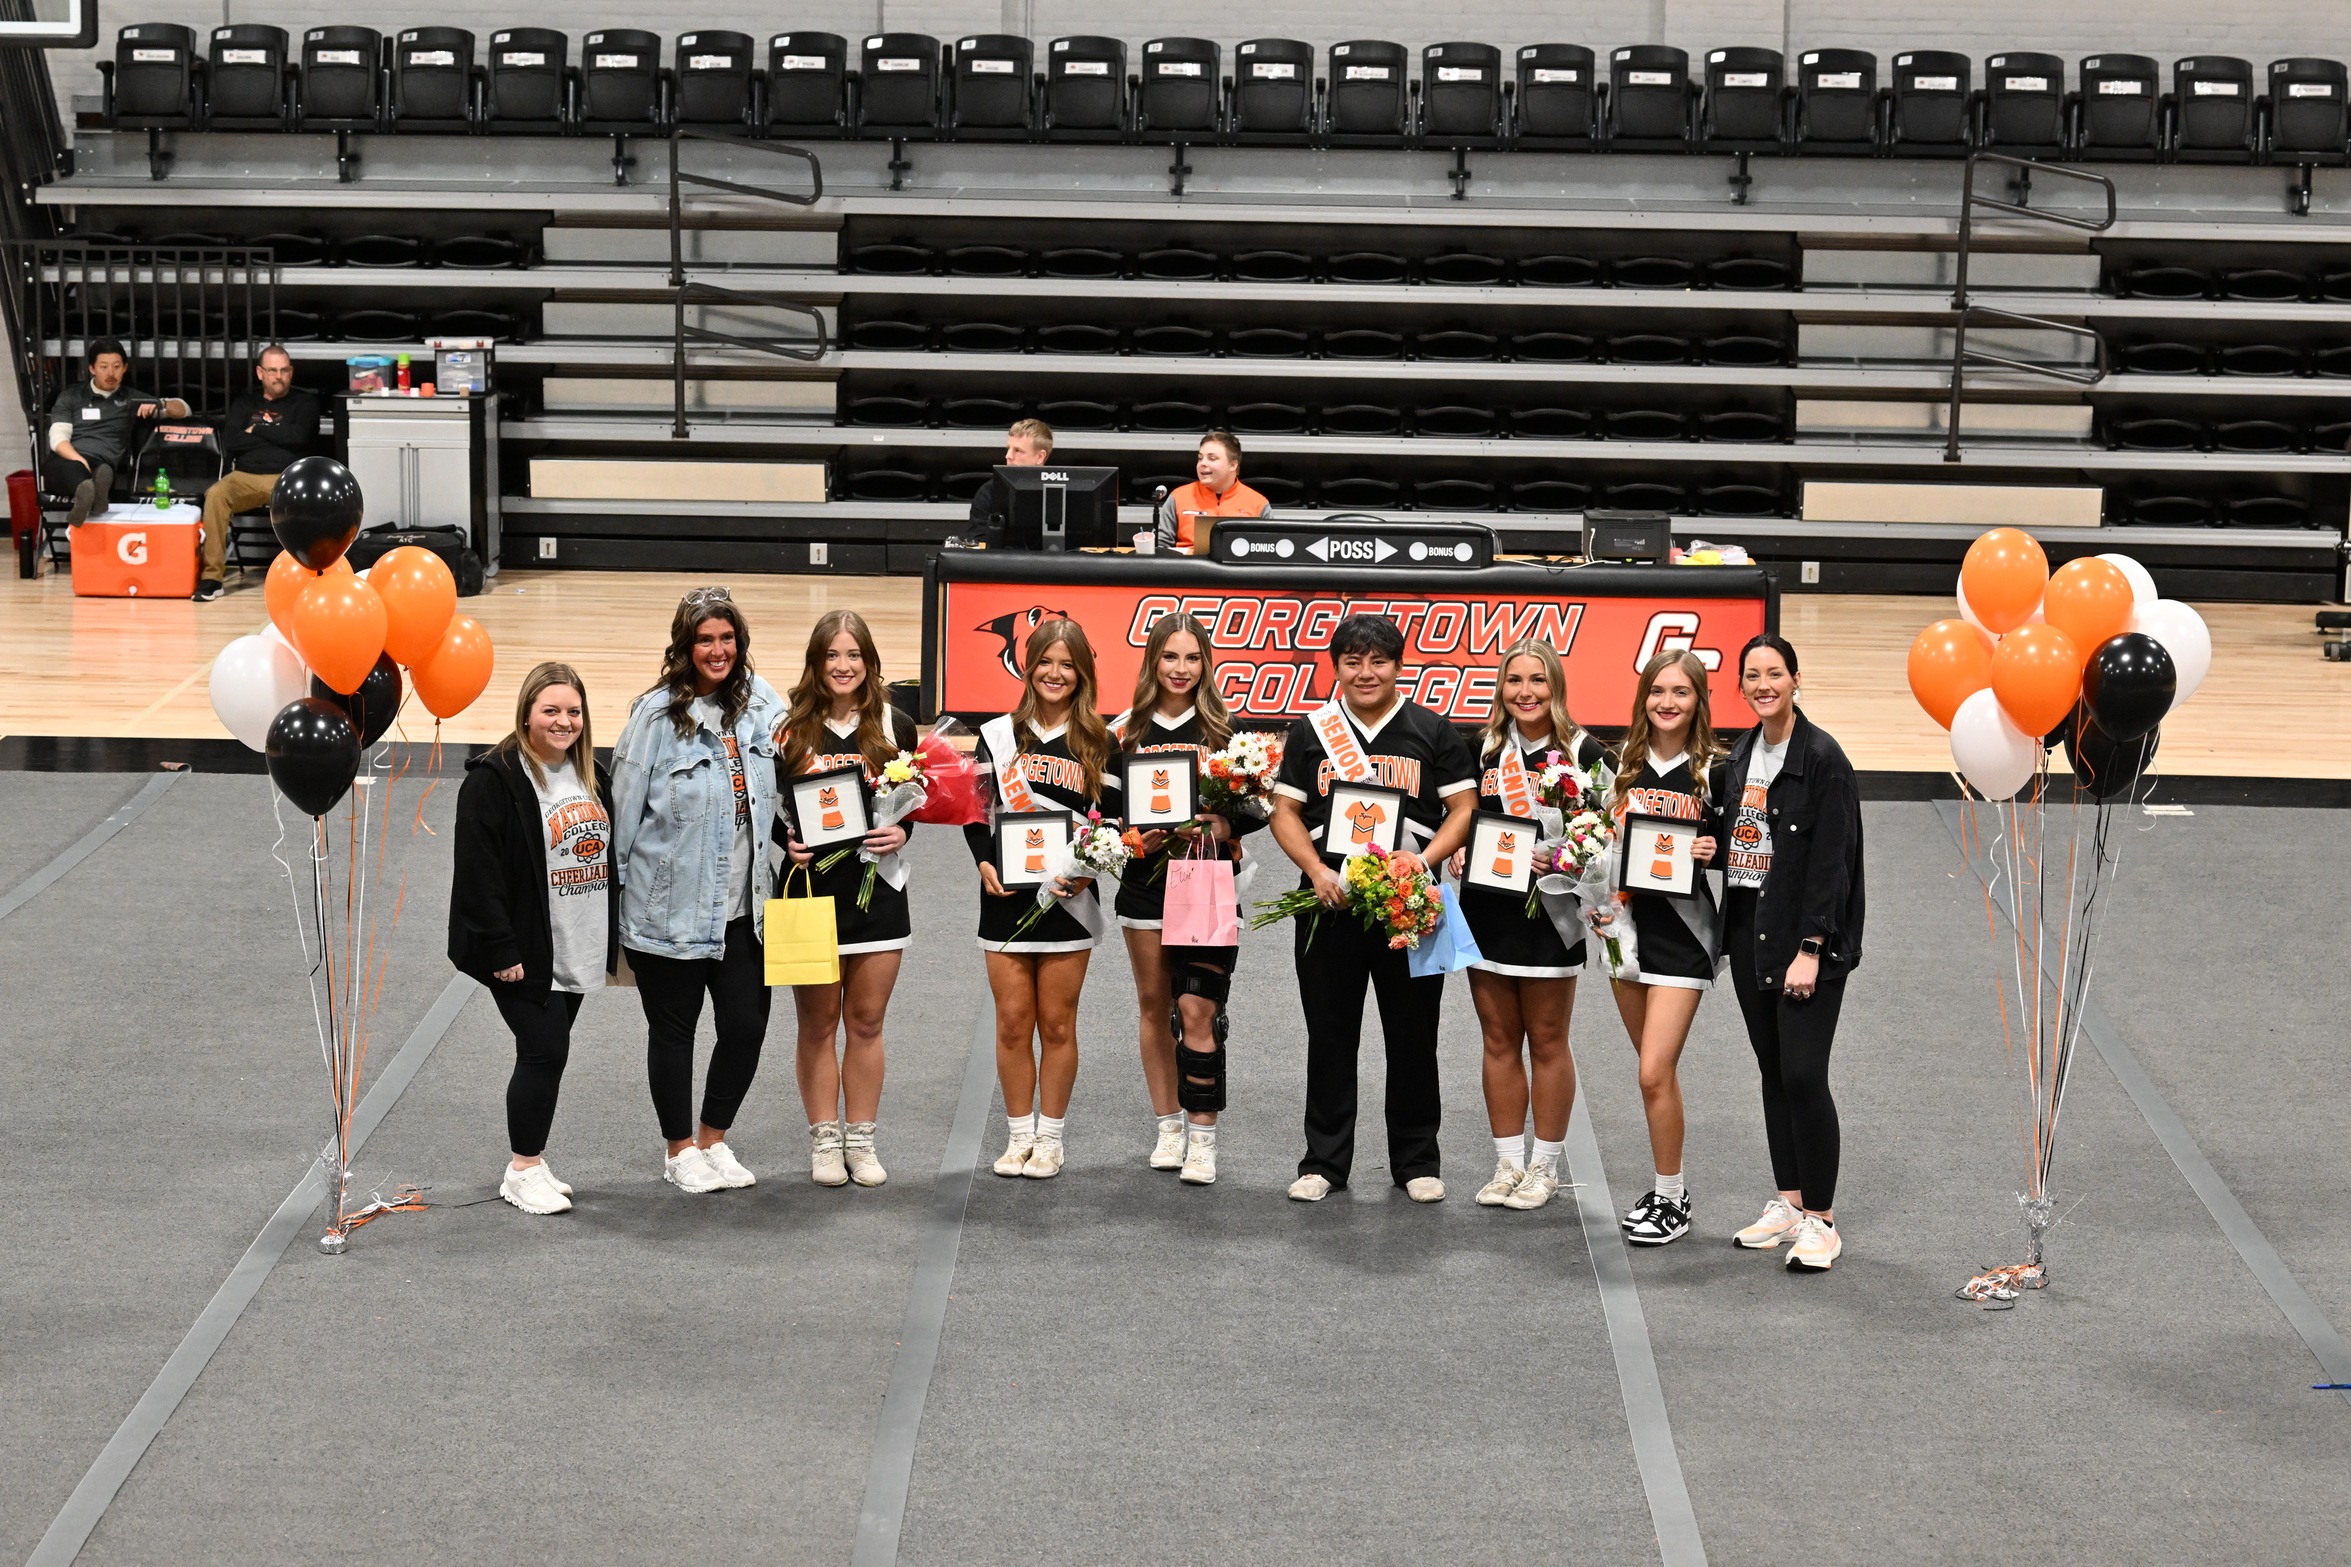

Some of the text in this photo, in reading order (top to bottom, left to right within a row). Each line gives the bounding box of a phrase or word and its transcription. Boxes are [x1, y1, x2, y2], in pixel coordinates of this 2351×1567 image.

[1041, 472, 1069, 481] DELL
[117, 532, 148, 565] G
[1250, 543, 1275, 553] BONUS
[1329, 540, 1374, 560] POSS
[1428, 547, 1454, 557] BONUS
[1213, 661, 1499, 719] COLGE
[1319, 714, 1365, 783] SENIOR
[1736, 829, 1759, 840] UCA
[560, 847, 569, 857] 20
[576, 842, 600, 853] UCA
